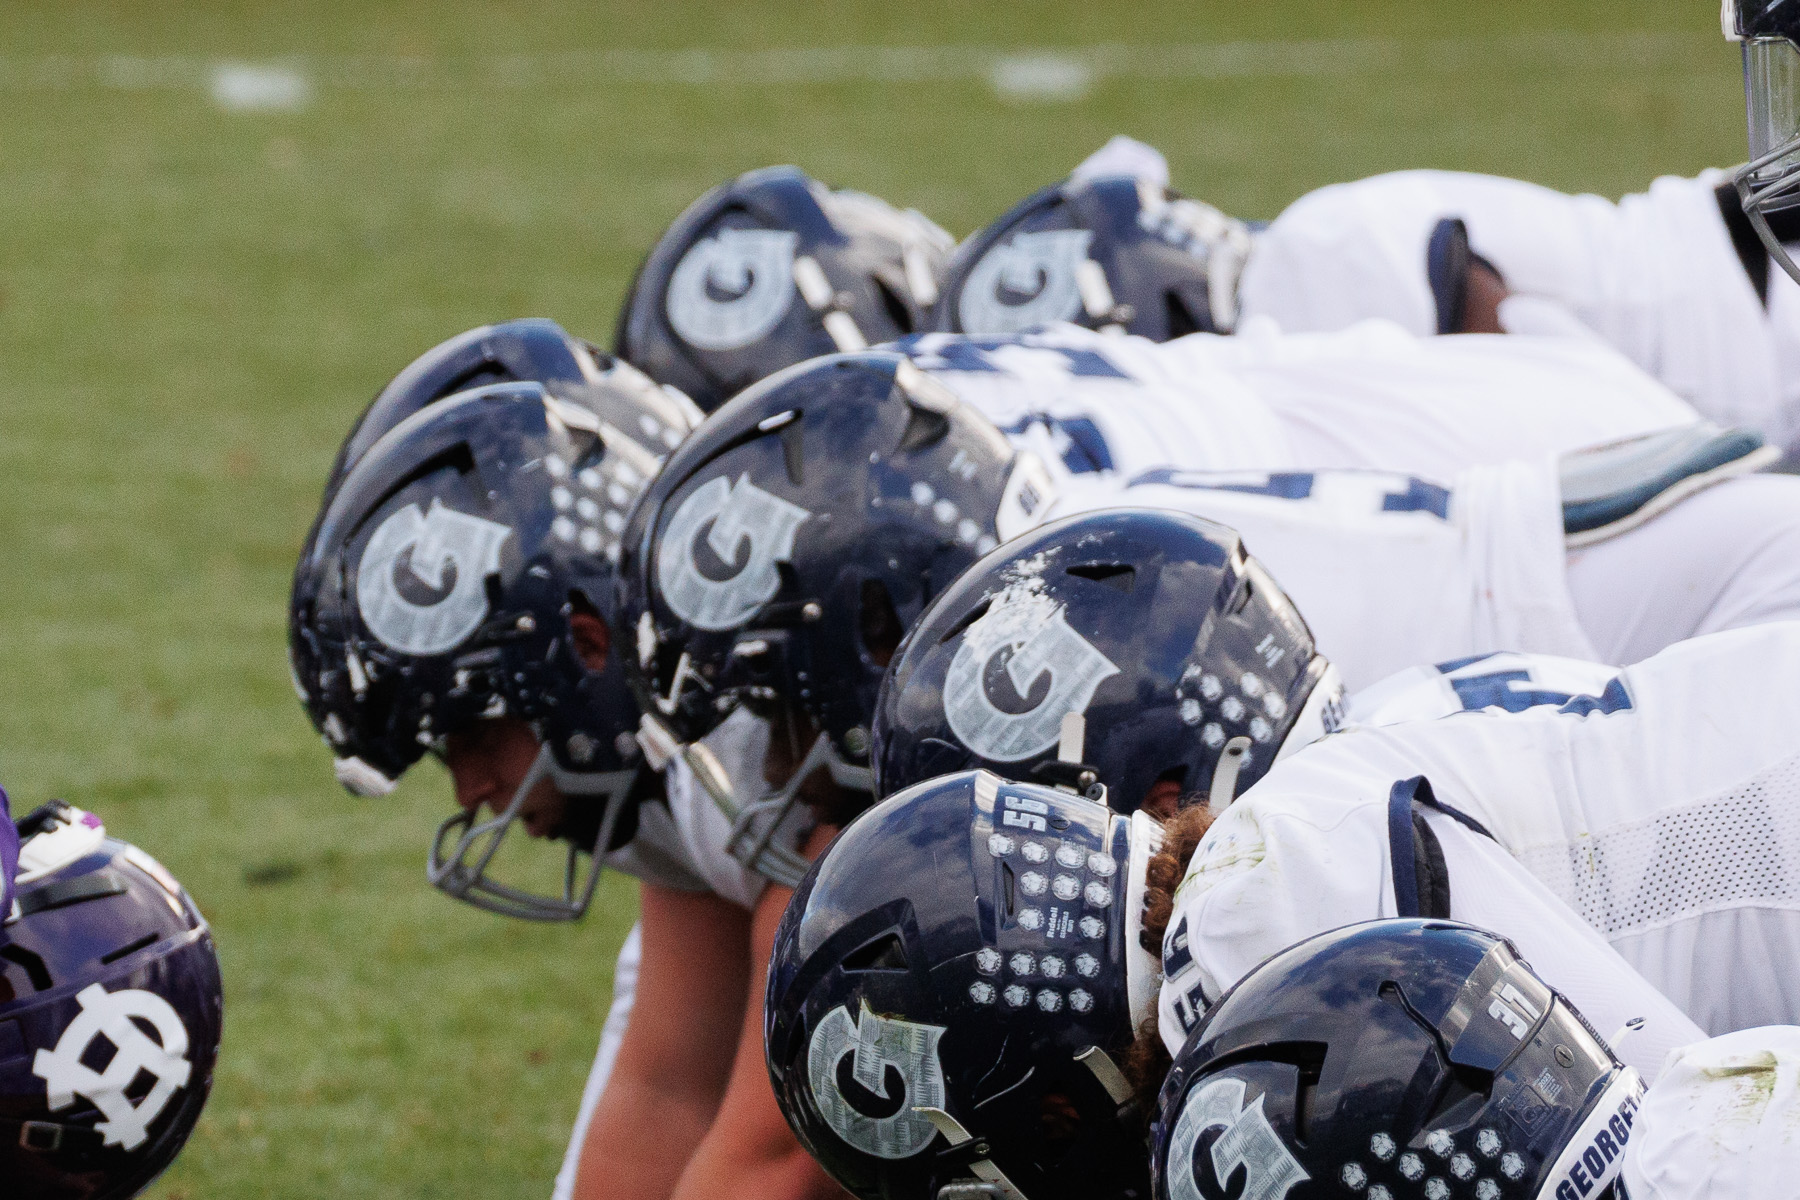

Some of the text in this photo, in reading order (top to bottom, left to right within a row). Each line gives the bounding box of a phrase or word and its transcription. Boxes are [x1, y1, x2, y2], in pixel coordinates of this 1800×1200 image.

[666, 227, 799, 351] G
[959, 229, 1094, 337] G
[356, 497, 512, 657] G
[658, 472, 812, 633] G
[943, 604, 1121, 763] G
[1003, 796, 1048, 832] 56
[1046, 906, 1058, 938] Riddell
[1487, 982, 1540, 1041] 37
[806, 997, 947, 1160] G
